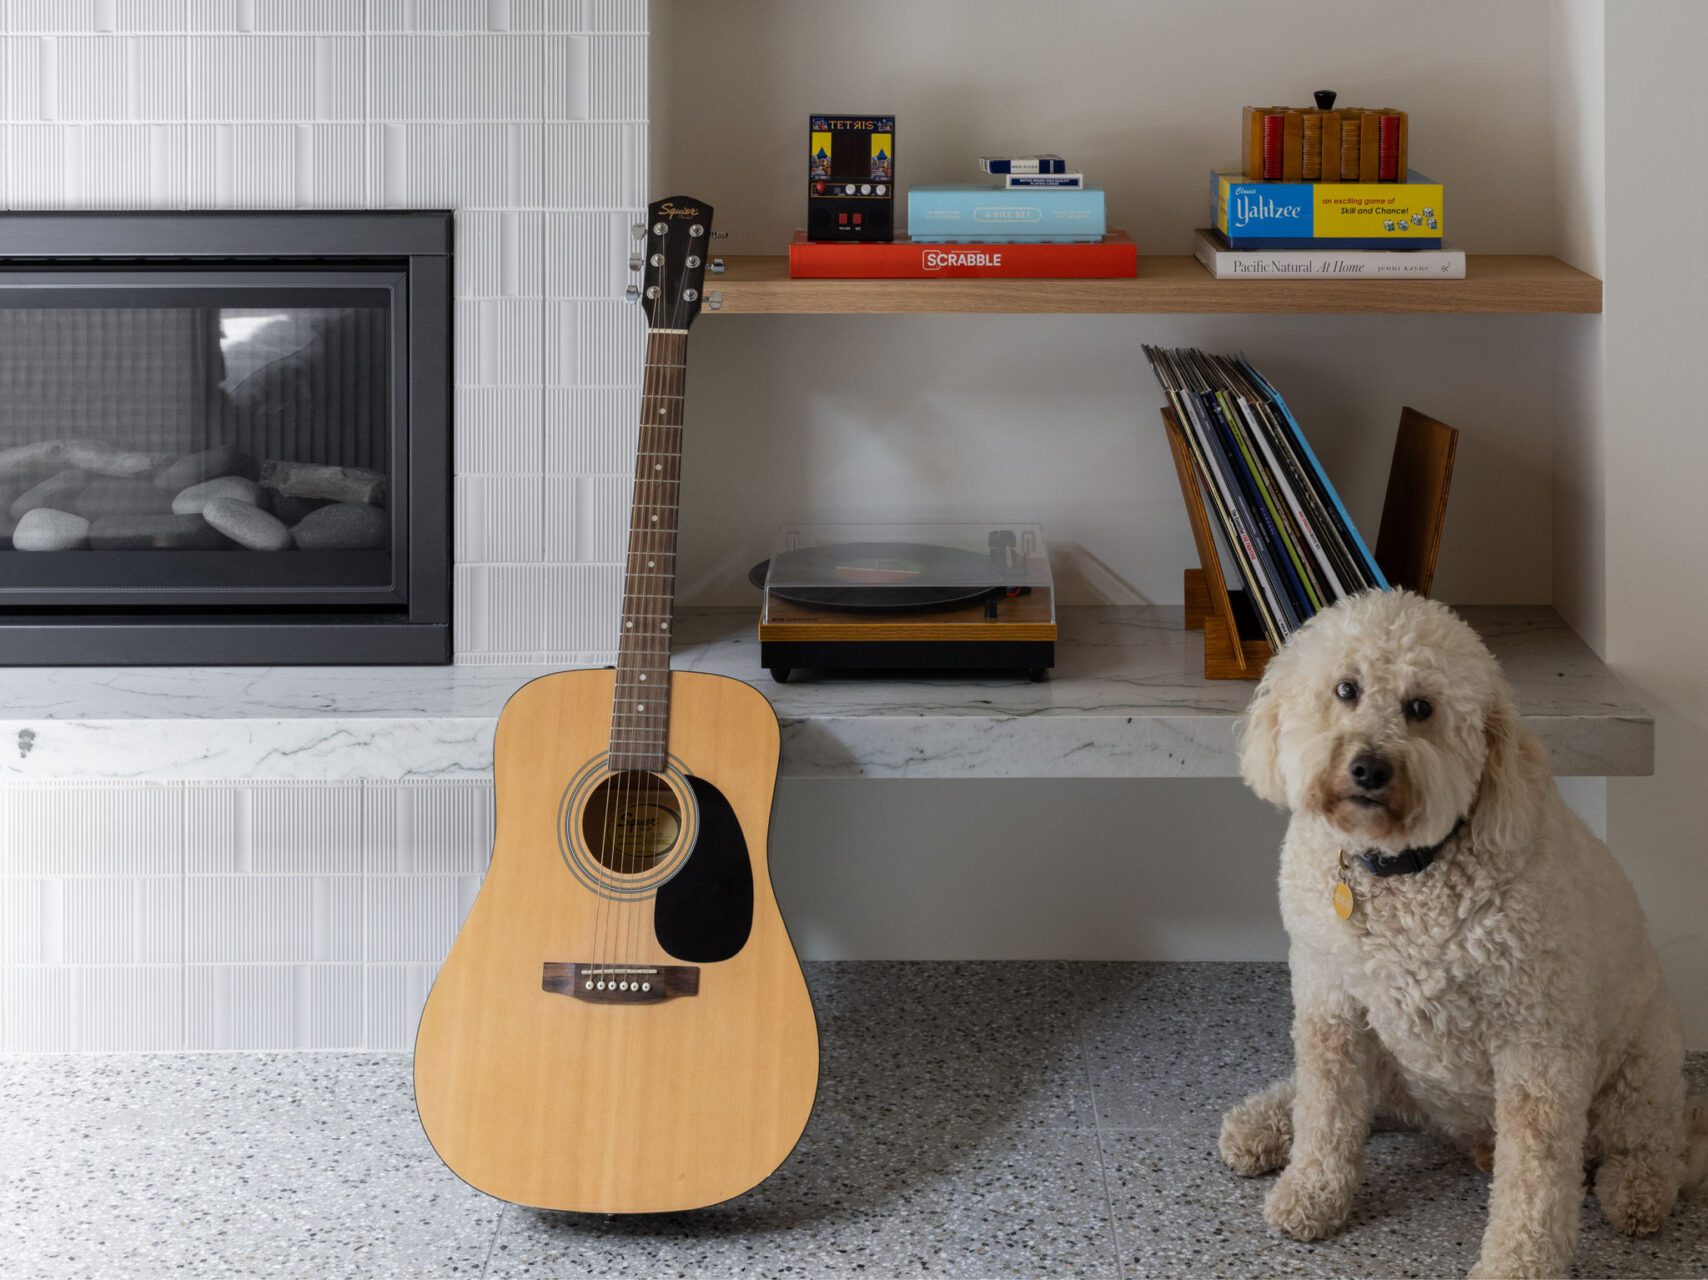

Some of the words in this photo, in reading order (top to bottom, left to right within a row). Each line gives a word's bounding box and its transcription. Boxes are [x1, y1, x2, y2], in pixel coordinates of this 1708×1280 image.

[1333, 197, 1363, 206] exciting
[1387, 197, 1396, 205] of
[658, 202, 699, 220] Squier
[1235, 194, 1301, 228] Yahtzee
[927, 253, 1002, 267] SCRABBLE
[1234, 259, 1269, 273] Pacific
[1271, 259, 1312, 273] Natural
[1316, 261, 1331, 273] At
[1332, 261, 1365, 273] Home
